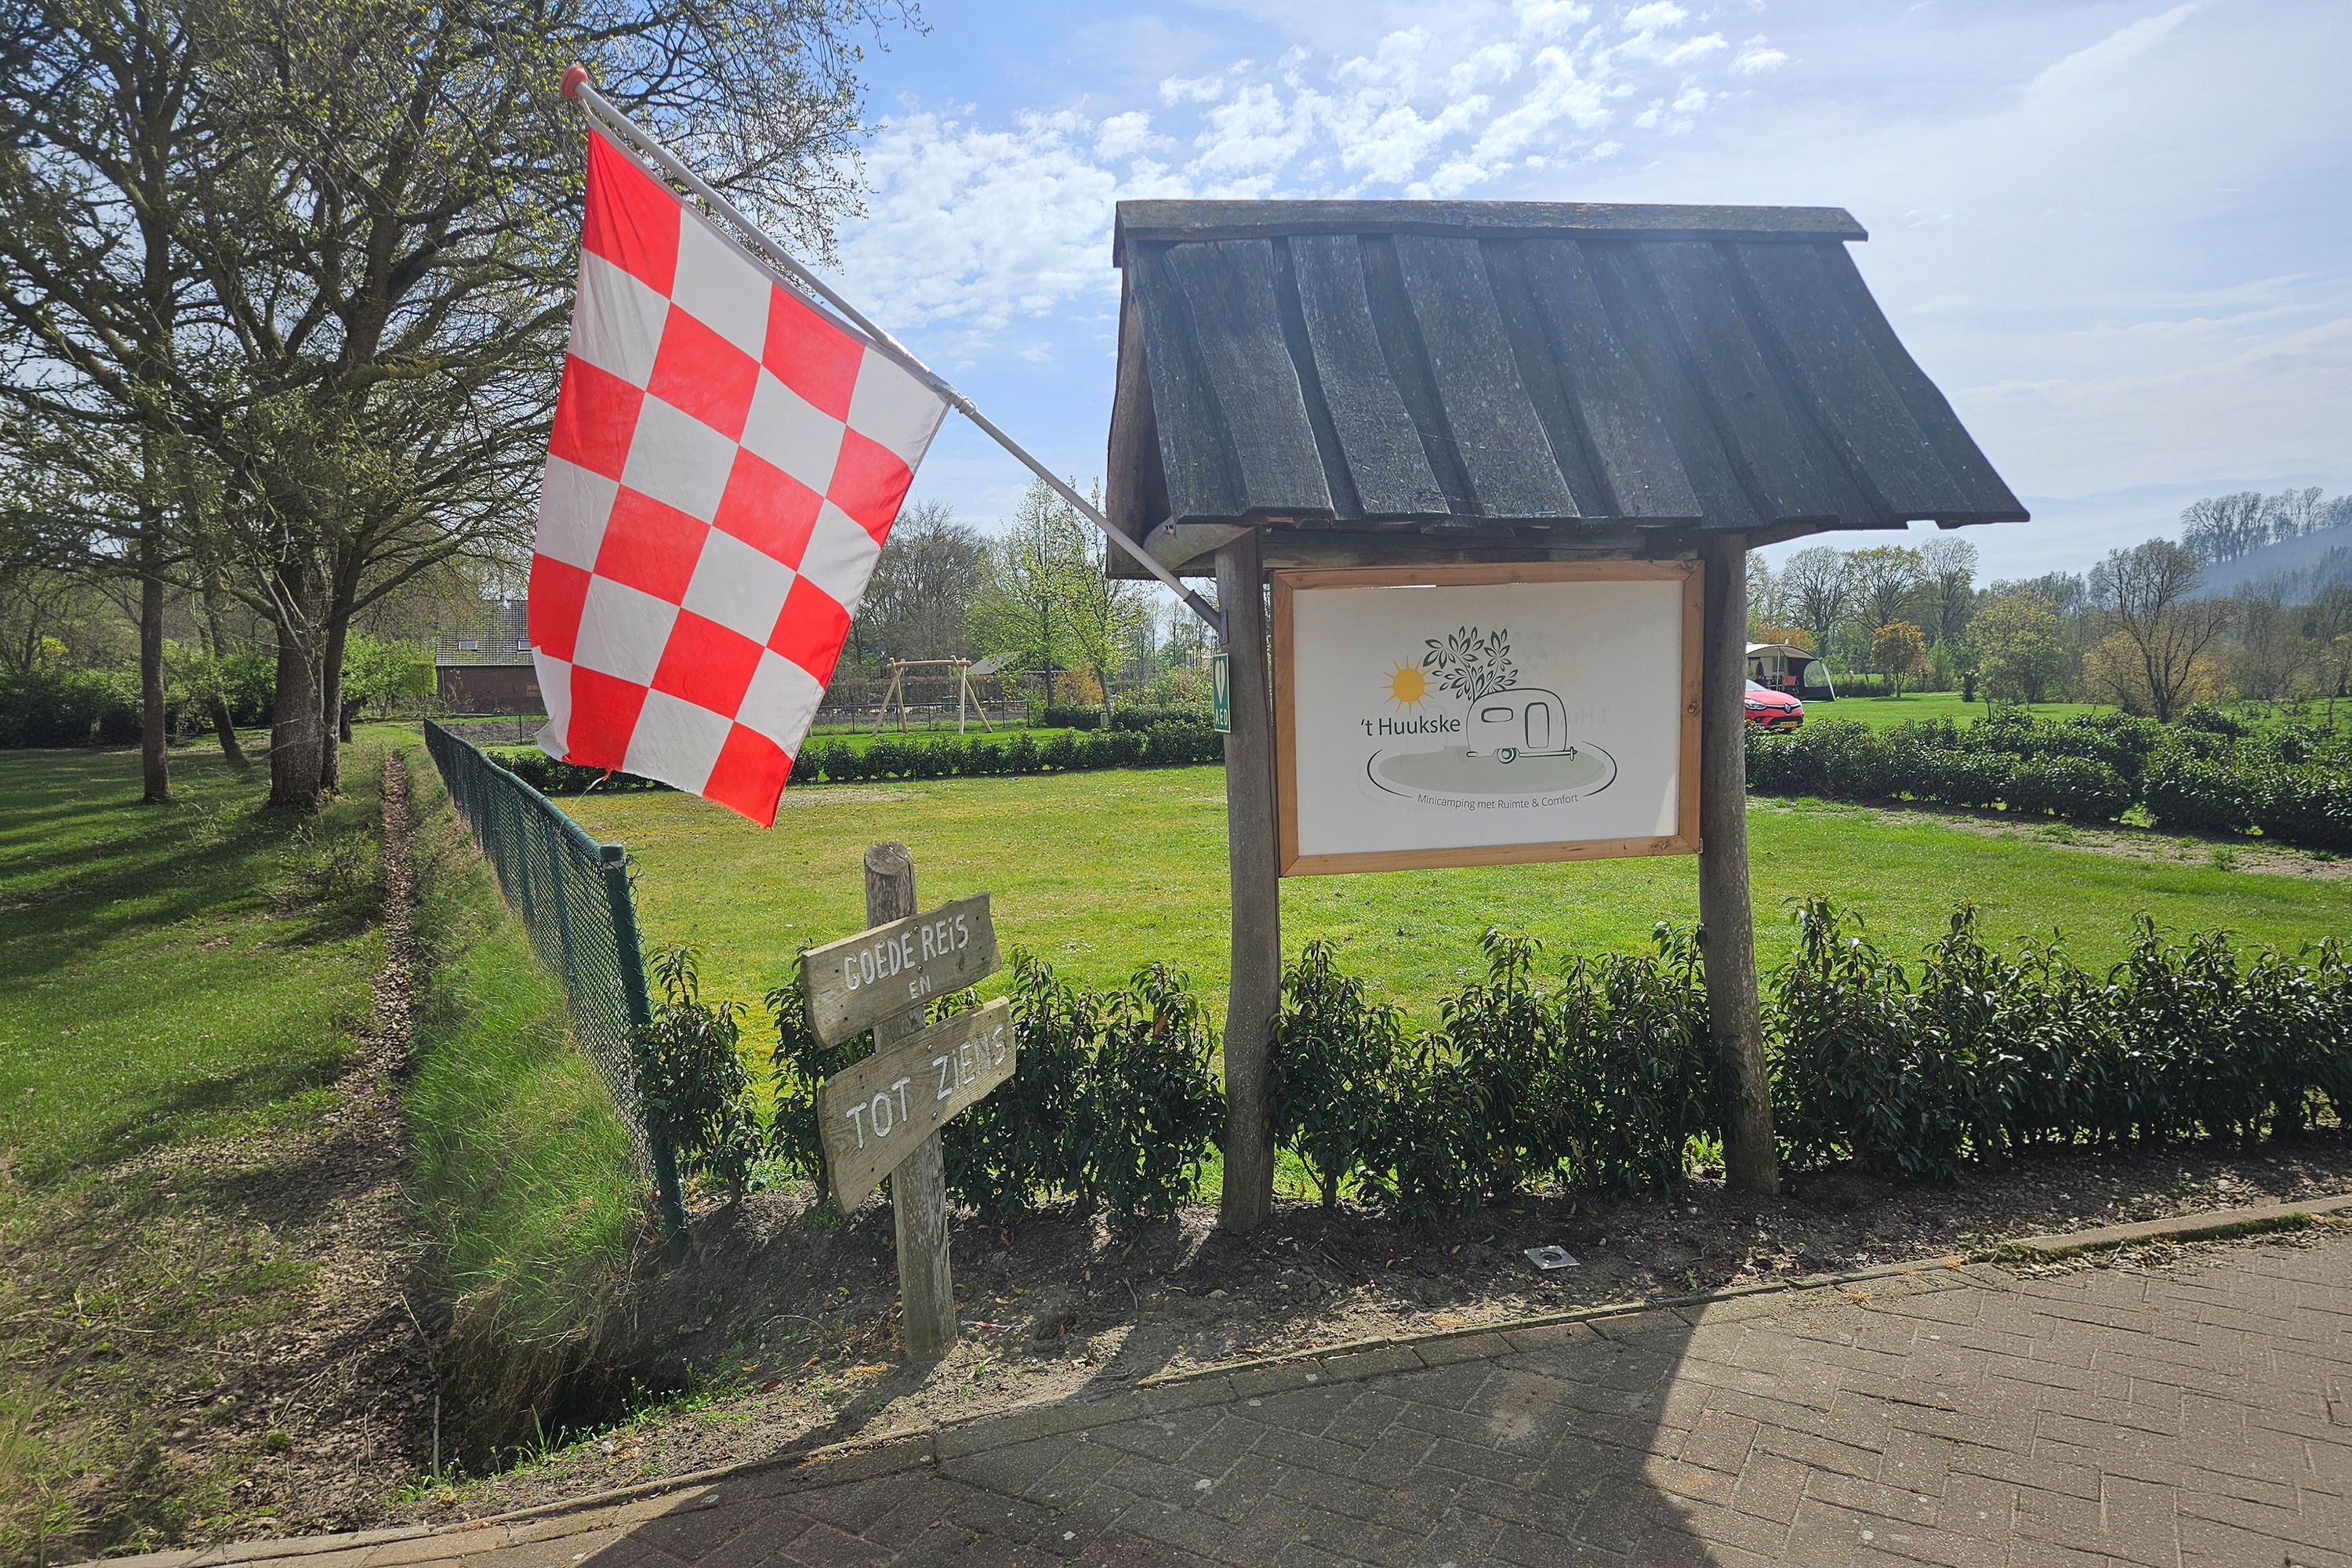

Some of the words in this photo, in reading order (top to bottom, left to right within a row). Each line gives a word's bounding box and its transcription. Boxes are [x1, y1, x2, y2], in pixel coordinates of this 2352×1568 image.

[1215, 708, 1229, 726] AED
[1379, 714, 1461, 735] Huukske
[1417, 793, 1475, 811] Minicamping
[1477, 799, 1495, 809] met
[1497, 799, 1530, 809] Ruimte
[1531, 798, 1539, 808] &
[1541, 794, 1579, 807] Comfort
[844, 931, 916, 990] GOEDE
[909, 975, 931, 1000] EN
[846, 1076, 911, 1149] TOT
